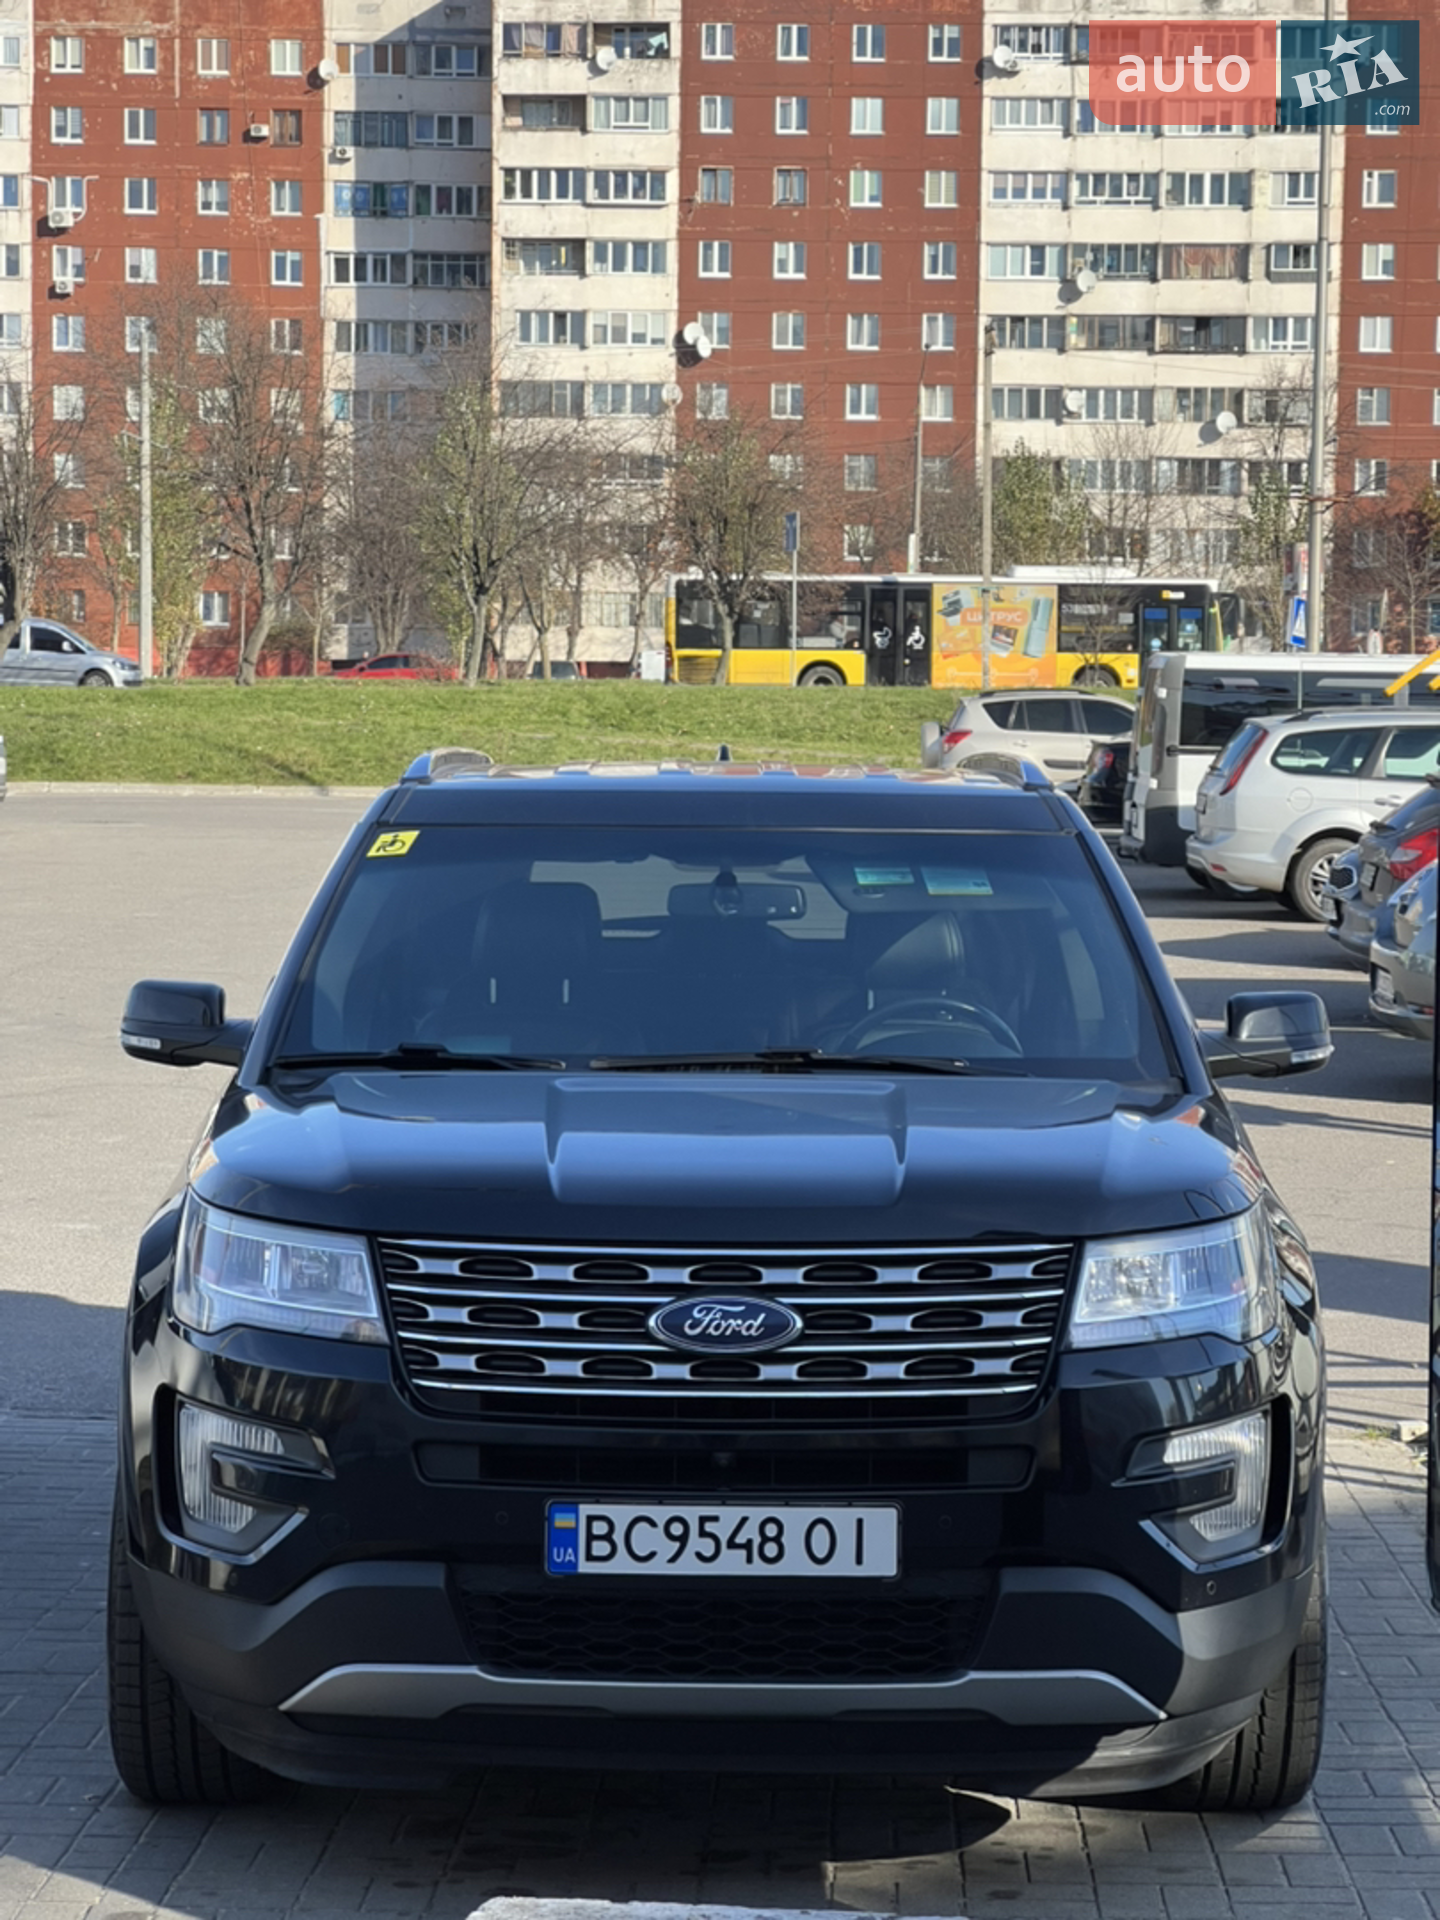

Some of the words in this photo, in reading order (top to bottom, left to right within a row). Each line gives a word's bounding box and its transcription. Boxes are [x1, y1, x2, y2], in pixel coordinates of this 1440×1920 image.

[683, 1303, 767, 1337] Ford
[552, 1546, 576, 1564] UA
[584, 1513, 786, 1566] BC9548
